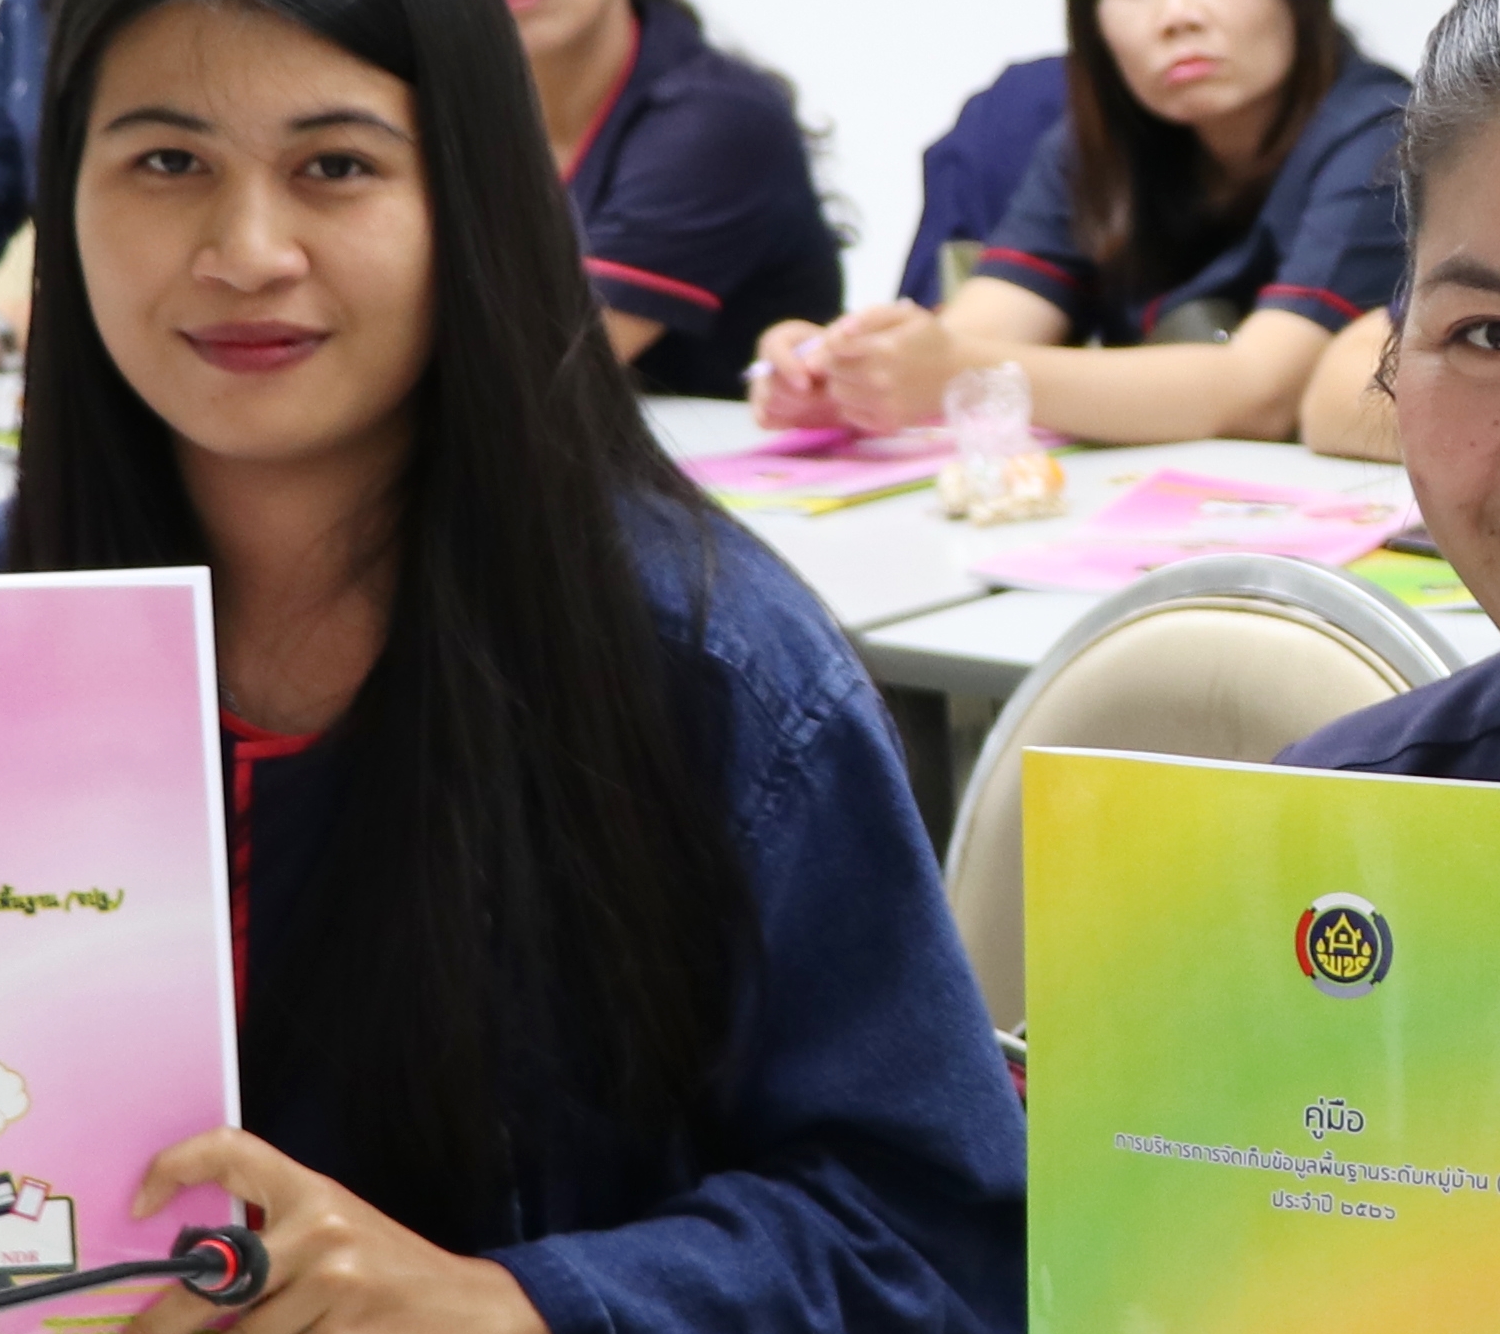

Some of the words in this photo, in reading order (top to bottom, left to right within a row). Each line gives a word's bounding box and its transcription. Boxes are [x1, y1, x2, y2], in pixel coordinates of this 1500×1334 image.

[1305, 1097, 1365, 1139] คู่มือ
[1273, 1190, 1333, 1213] ประจำปี
